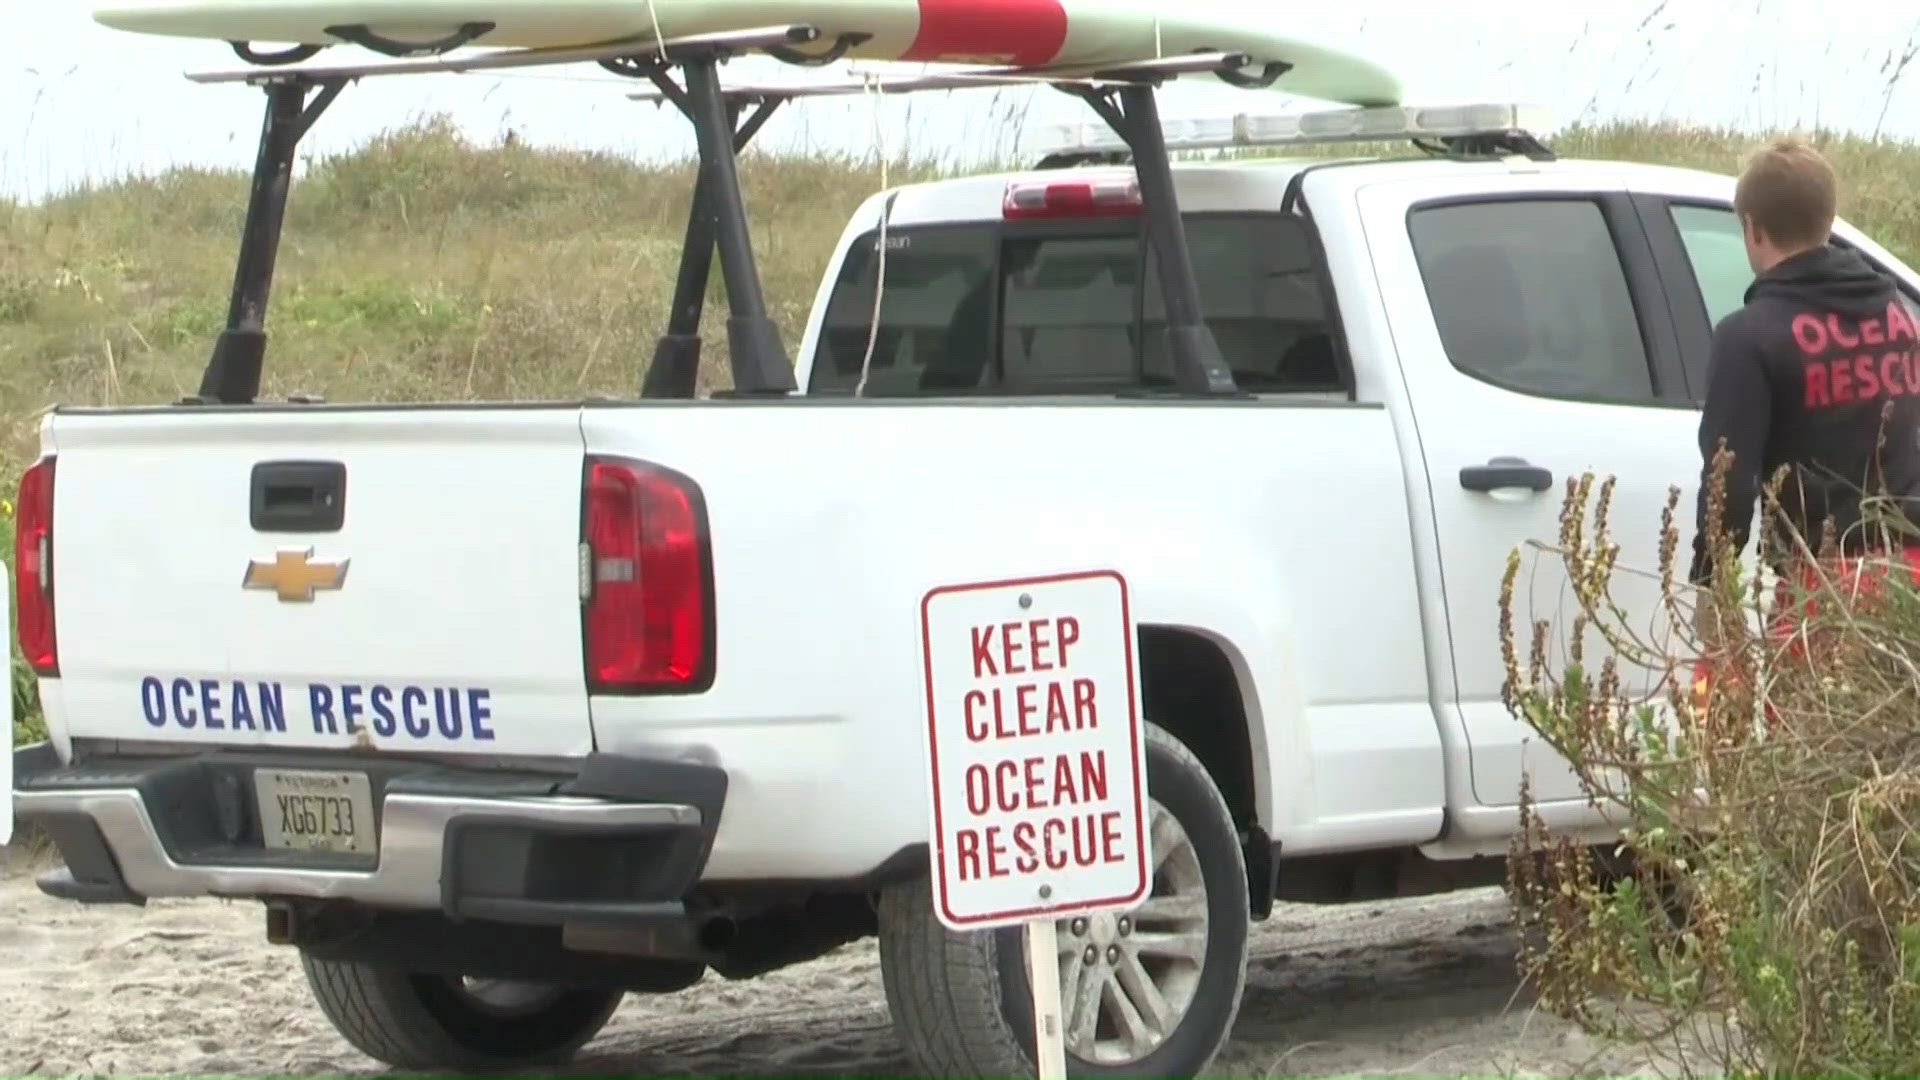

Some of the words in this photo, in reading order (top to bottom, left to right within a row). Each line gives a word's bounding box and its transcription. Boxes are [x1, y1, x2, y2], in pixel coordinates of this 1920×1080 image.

[971, 616, 1080, 678] KEEP
[142, 676, 287, 732] OCEAN
[309, 683, 495, 741] RESCUE
[963, 678, 1098, 742] CLEAR
[277, 795, 354, 835] XG6733
[965, 750, 1108, 816] OCEAN
[956, 812, 1125, 881] RESCUE
